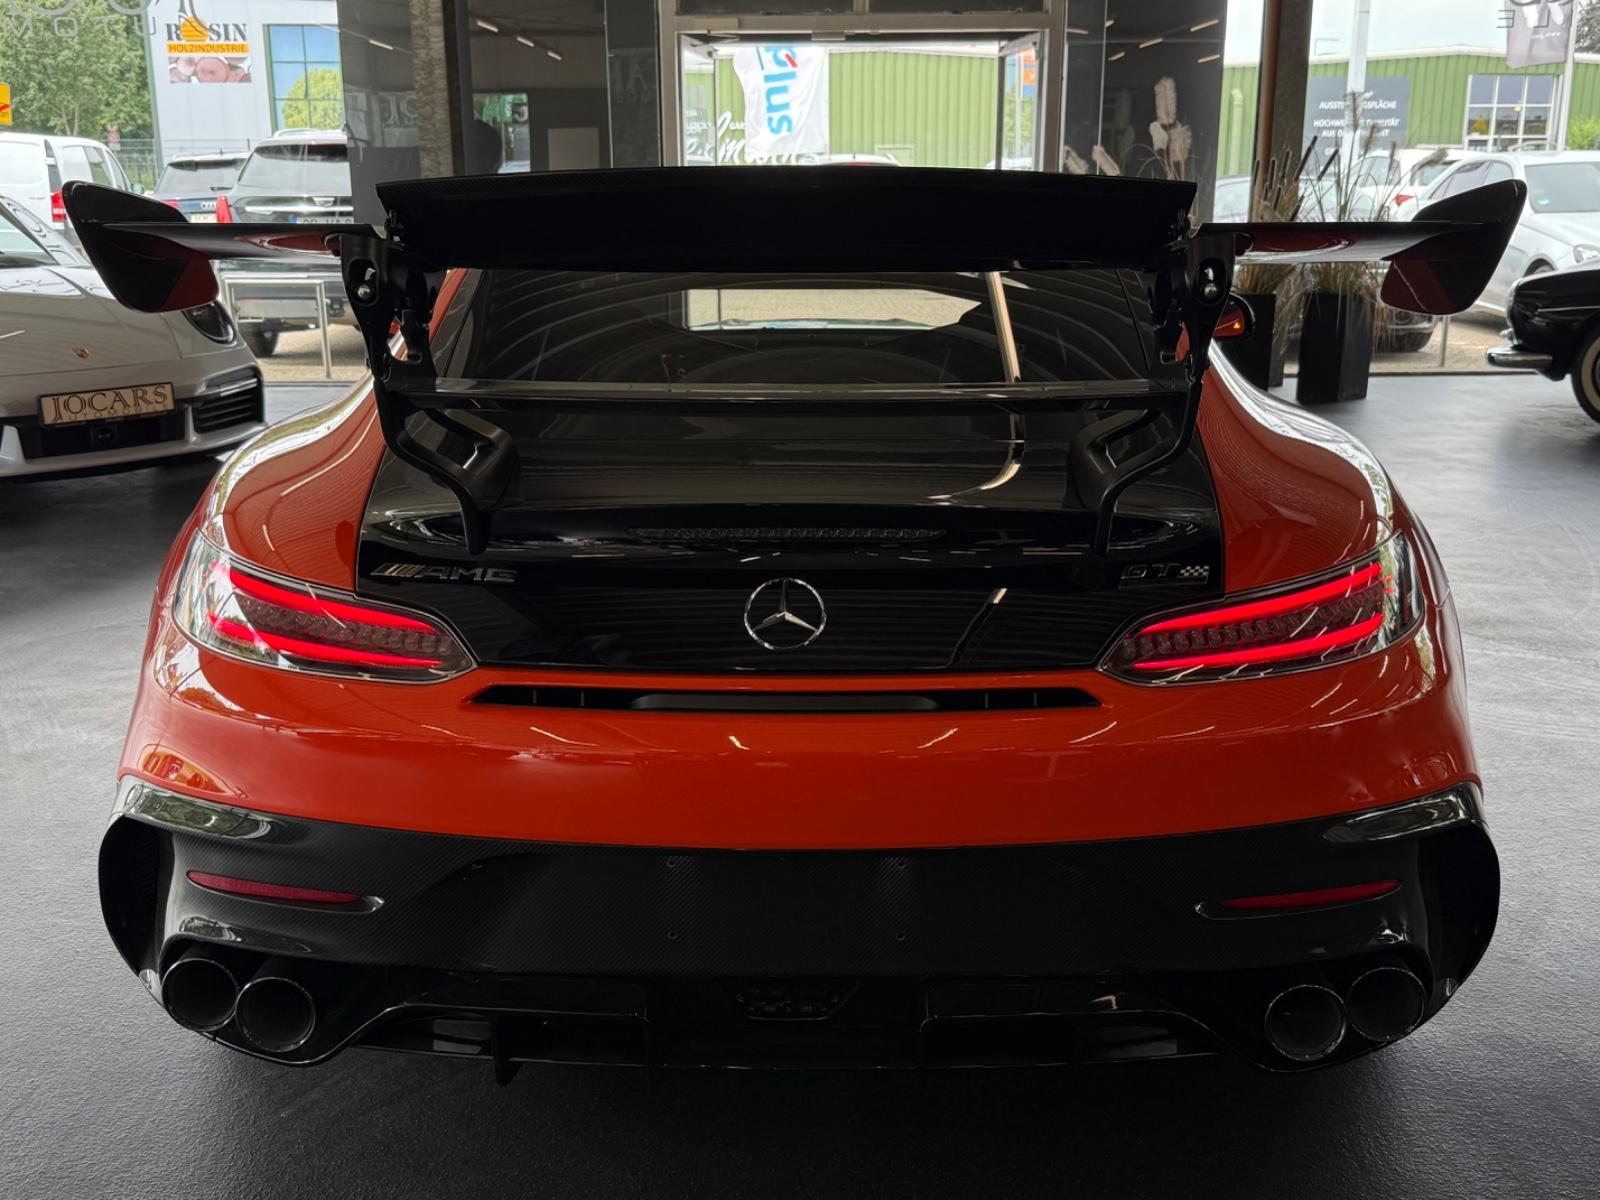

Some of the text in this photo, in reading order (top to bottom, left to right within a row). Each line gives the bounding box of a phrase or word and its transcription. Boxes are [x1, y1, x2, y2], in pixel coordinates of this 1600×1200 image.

[168, 44, 248, 53] HOLZINDUSTRIE
[51, 384, 168, 422] JOCARS
[414, 566, 517, 583] AMG
[1120, 564, 1182, 579] GT
